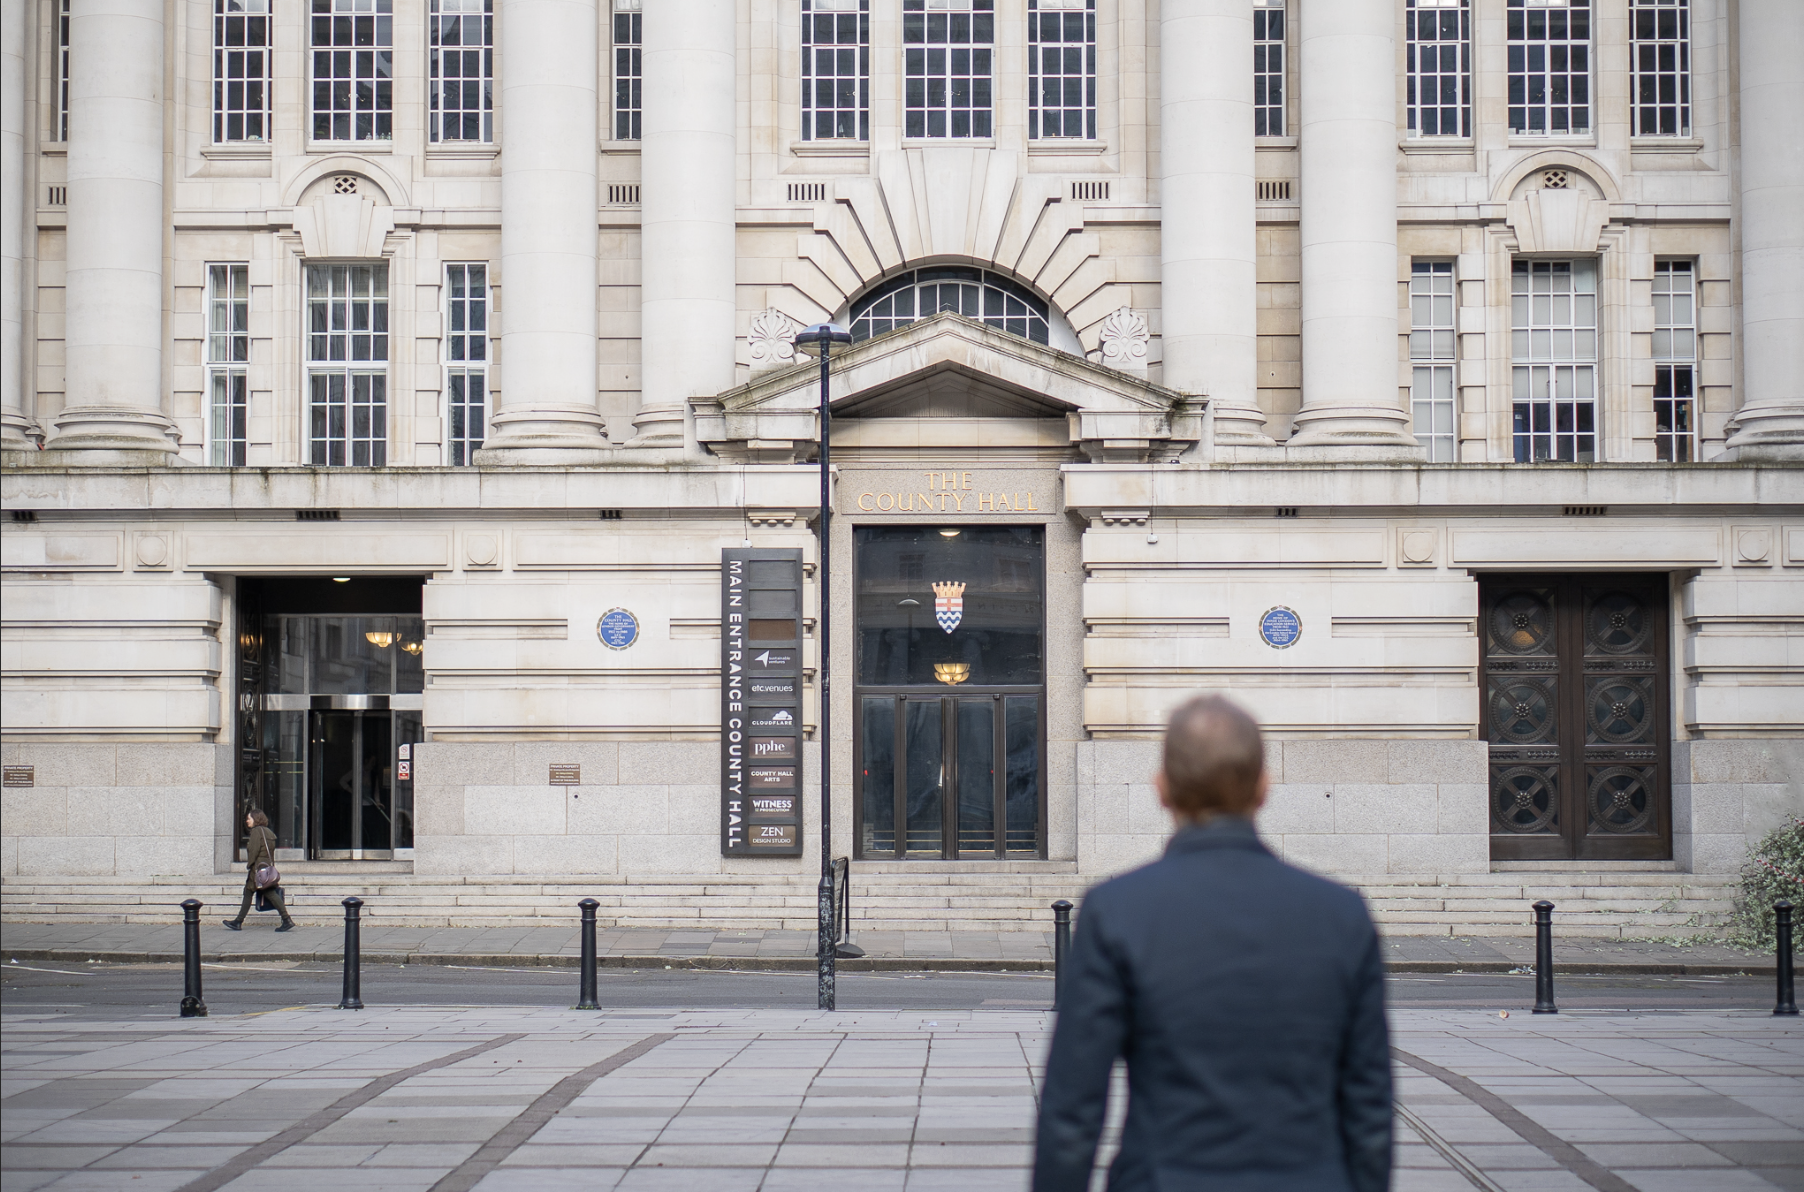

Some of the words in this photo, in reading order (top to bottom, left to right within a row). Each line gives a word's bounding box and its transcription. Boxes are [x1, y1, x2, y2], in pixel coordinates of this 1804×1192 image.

[924, 472, 972, 490] THE
[857, 492, 967, 511] COUNTY
[978, 492, 1038, 511] HALL
[729, 560, 742, 606] MAIN
[729, 613, 742, 711] ENTRANCE
[752, 684, 793, 692] etc.venues
[729, 718, 742, 795] COUNTY
[754, 740, 785, 755] pphe
[752, 800, 792, 808] WITNESS
[728, 801, 742, 847] HALL
[761, 827, 783, 836] ZEN
